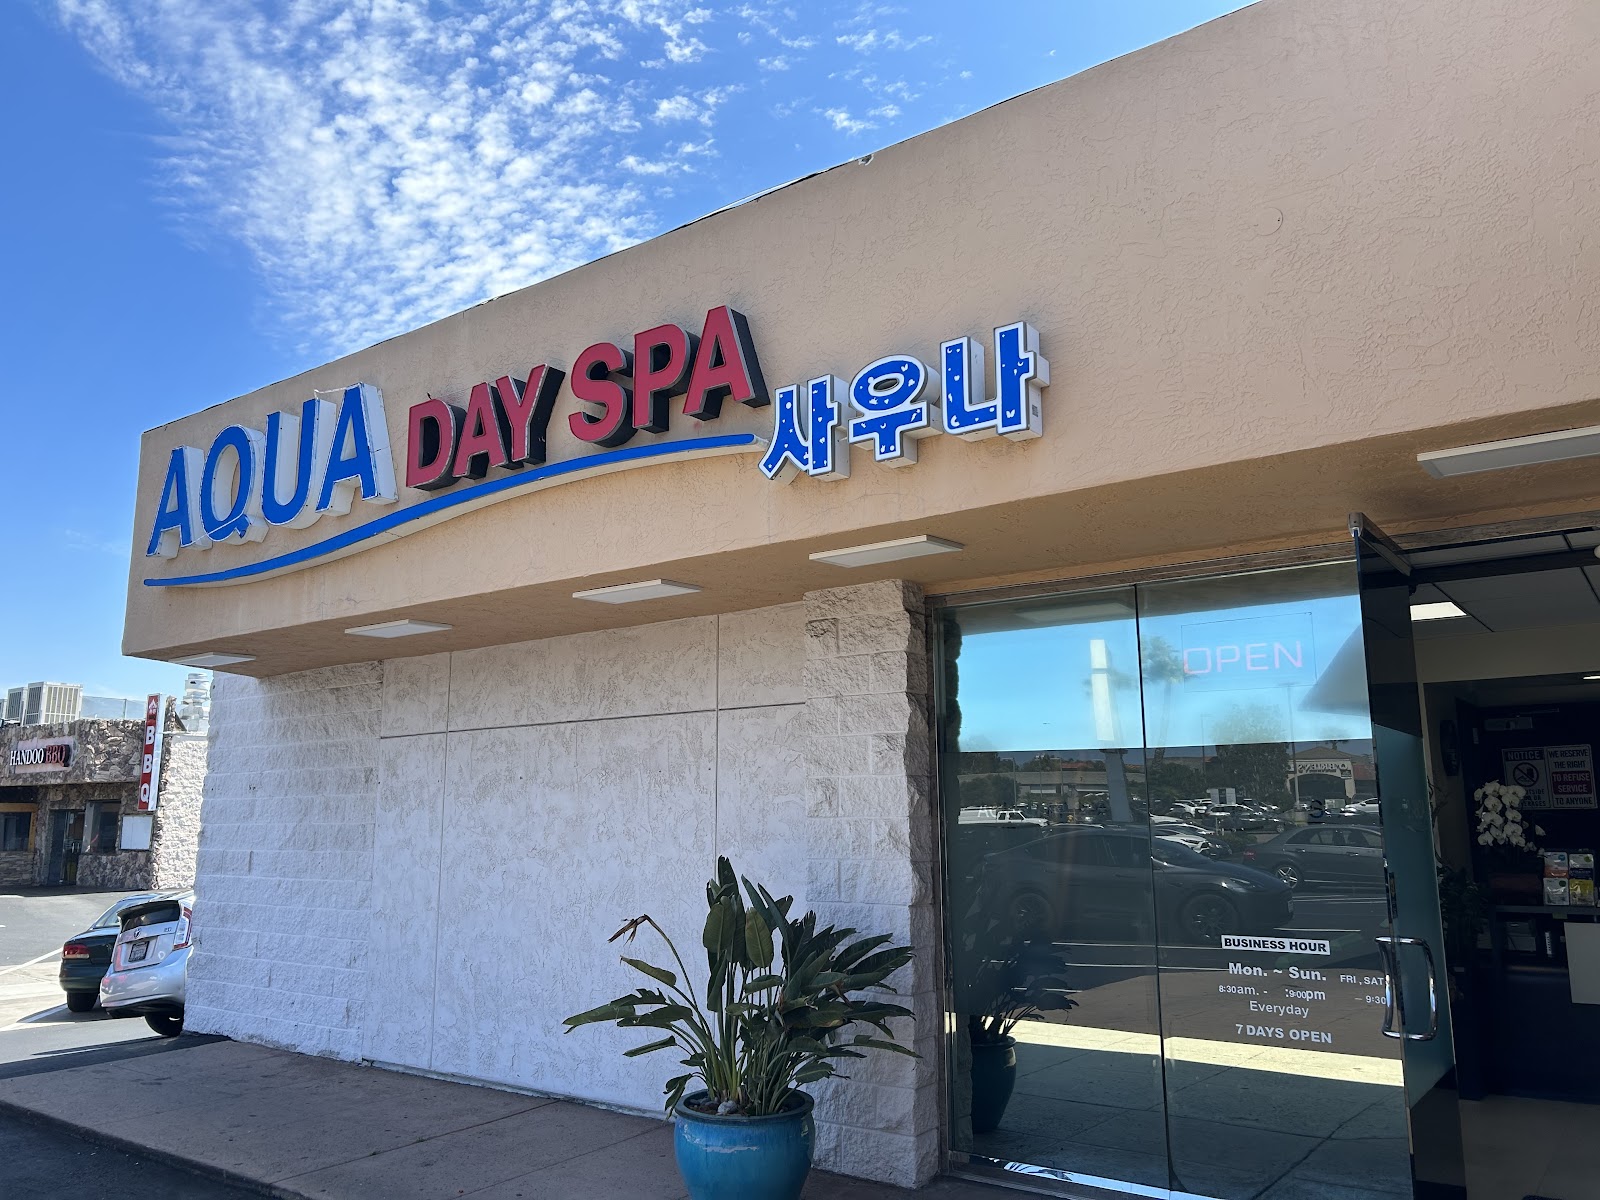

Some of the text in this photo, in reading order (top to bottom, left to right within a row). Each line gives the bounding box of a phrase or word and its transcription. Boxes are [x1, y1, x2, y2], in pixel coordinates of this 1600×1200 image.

[758, 320, 1044, 481] 사우나
[146, 305, 763, 559] AQUA DAY SPA
[1183, 641, 1303, 675] OPEN
[10, 744, 67, 766] HANDOO BBQ
[1507, 750, 1541, 760] NOTICE
[1548, 749, 1589, 758] WE RESERVE
[140, 725, 155, 803] BBQ
[1553, 760, 1586, 769] THE RIGHT
[1552, 773, 1590, 782] TO REFUSE
[1557, 784, 1588, 793] SERVICE
[1555, 797, 1592, 805] TO ANYONE
[1224, 937, 1327, 953] BUSINESS HOUR
[1228, 962, 1268, 977] Mon.
[1288, 966, 1327, 981] Sun.
[1365, 995, 1387, 1005] 9:30
[1249, 1000, 1309, 1018] Everyday
[1246, 1024, 1285, 1039] DAYS
[1289, 1029, 1333, 1044] OPEN
